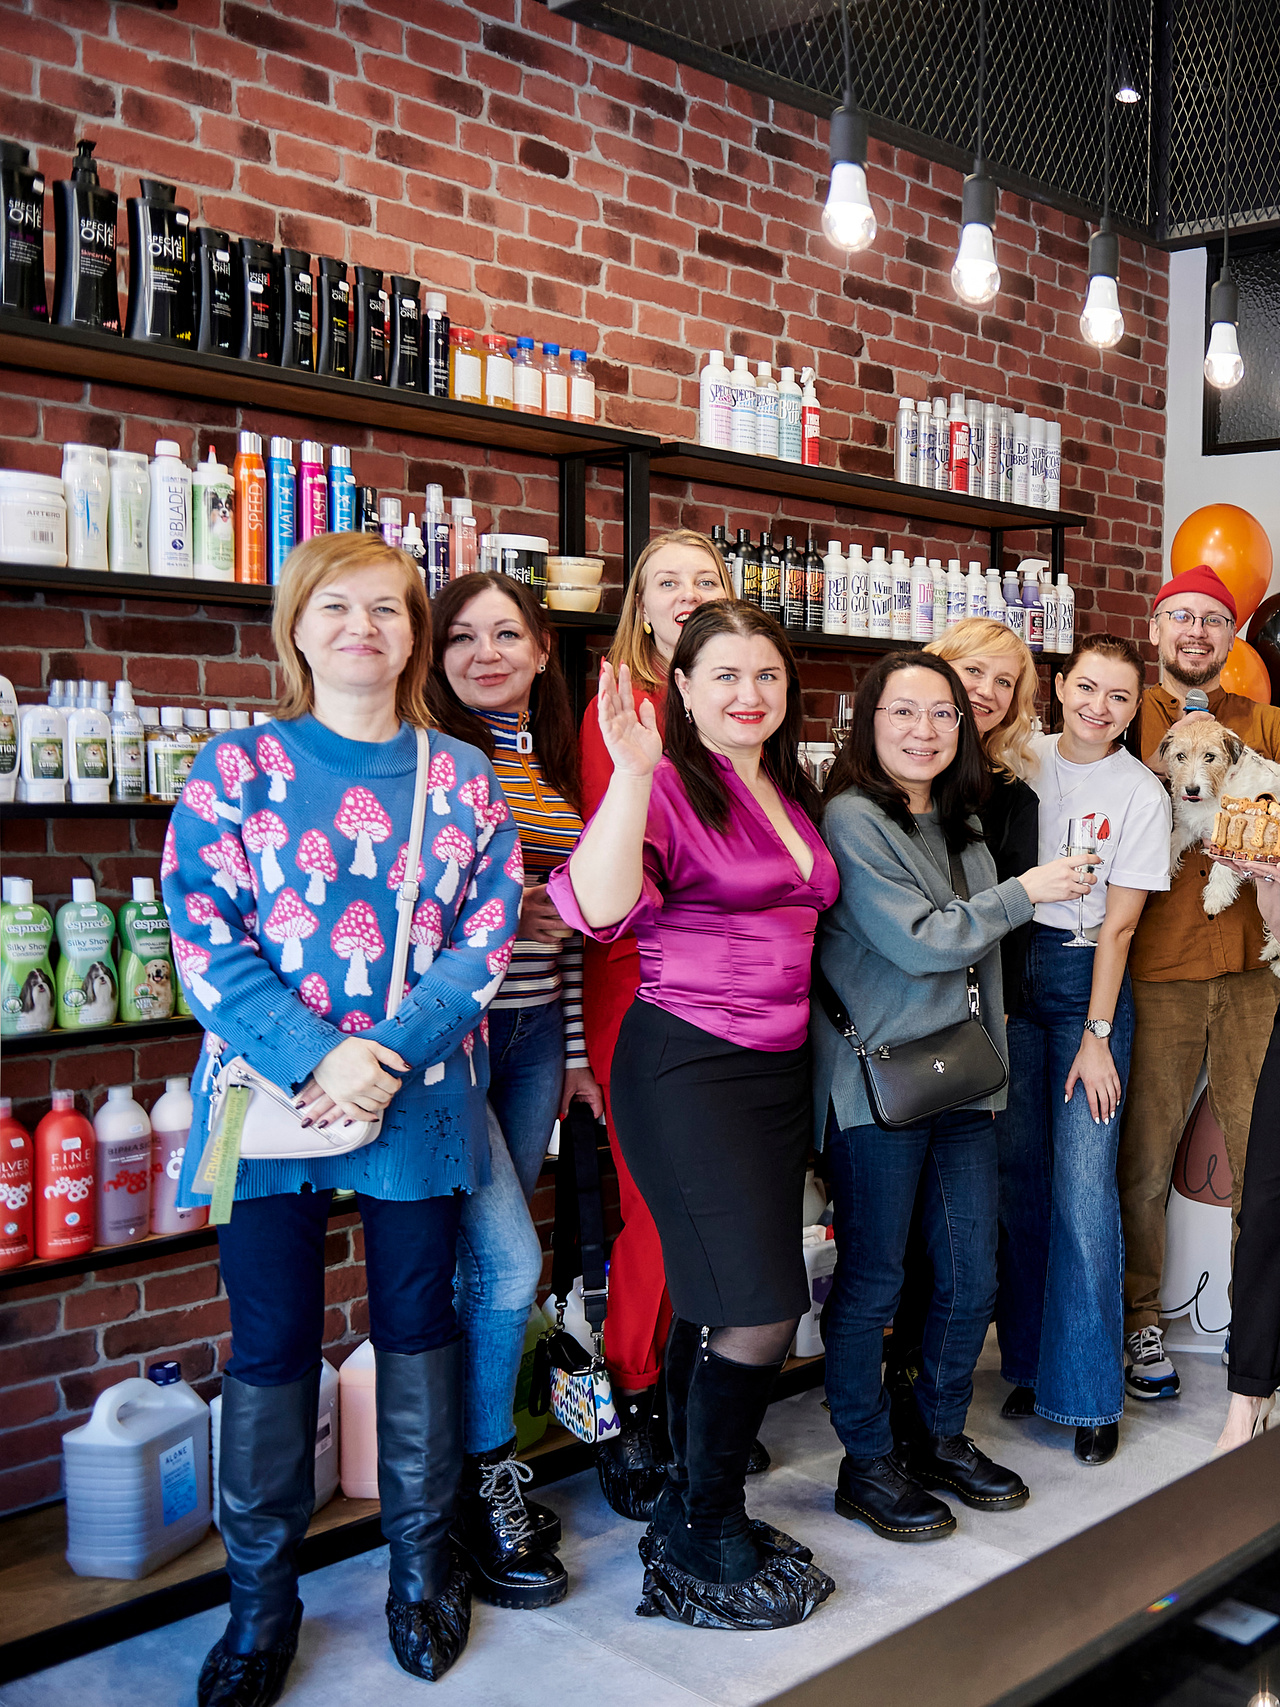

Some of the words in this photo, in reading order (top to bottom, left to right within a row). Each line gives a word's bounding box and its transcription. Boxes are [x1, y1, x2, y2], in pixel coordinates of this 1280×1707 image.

[9, 208, 42, 229] ONE
[80, 218, 114, 233] SPECIAL
[81, 227, 114, 248] ONE
[147, 235, 182, 247] SPECIAL
[148, 242, 183, 260] ONE
[250, 275, 268, 285] ONE
[169, 485, 184, 531] BLADE
[248, 483, 263, 531] SPEED
[27, 509, 61, 519] ARTERO
[828, 576, 848, 597] RED
[828, 595, 848, 612] RED
[38, 761, 59, 769] LOTION
[83, 761, 104, 769] LOTION
[7, 924, 46, 936] espree
[67, 920, 106, 932] espree
[7, 943, 27, 951] Silky
[67, 939, 88, 947] Silky
[51, 1148, 91, 1165] FINE
[51, 1161, 91, 1172] SHAMPOO
